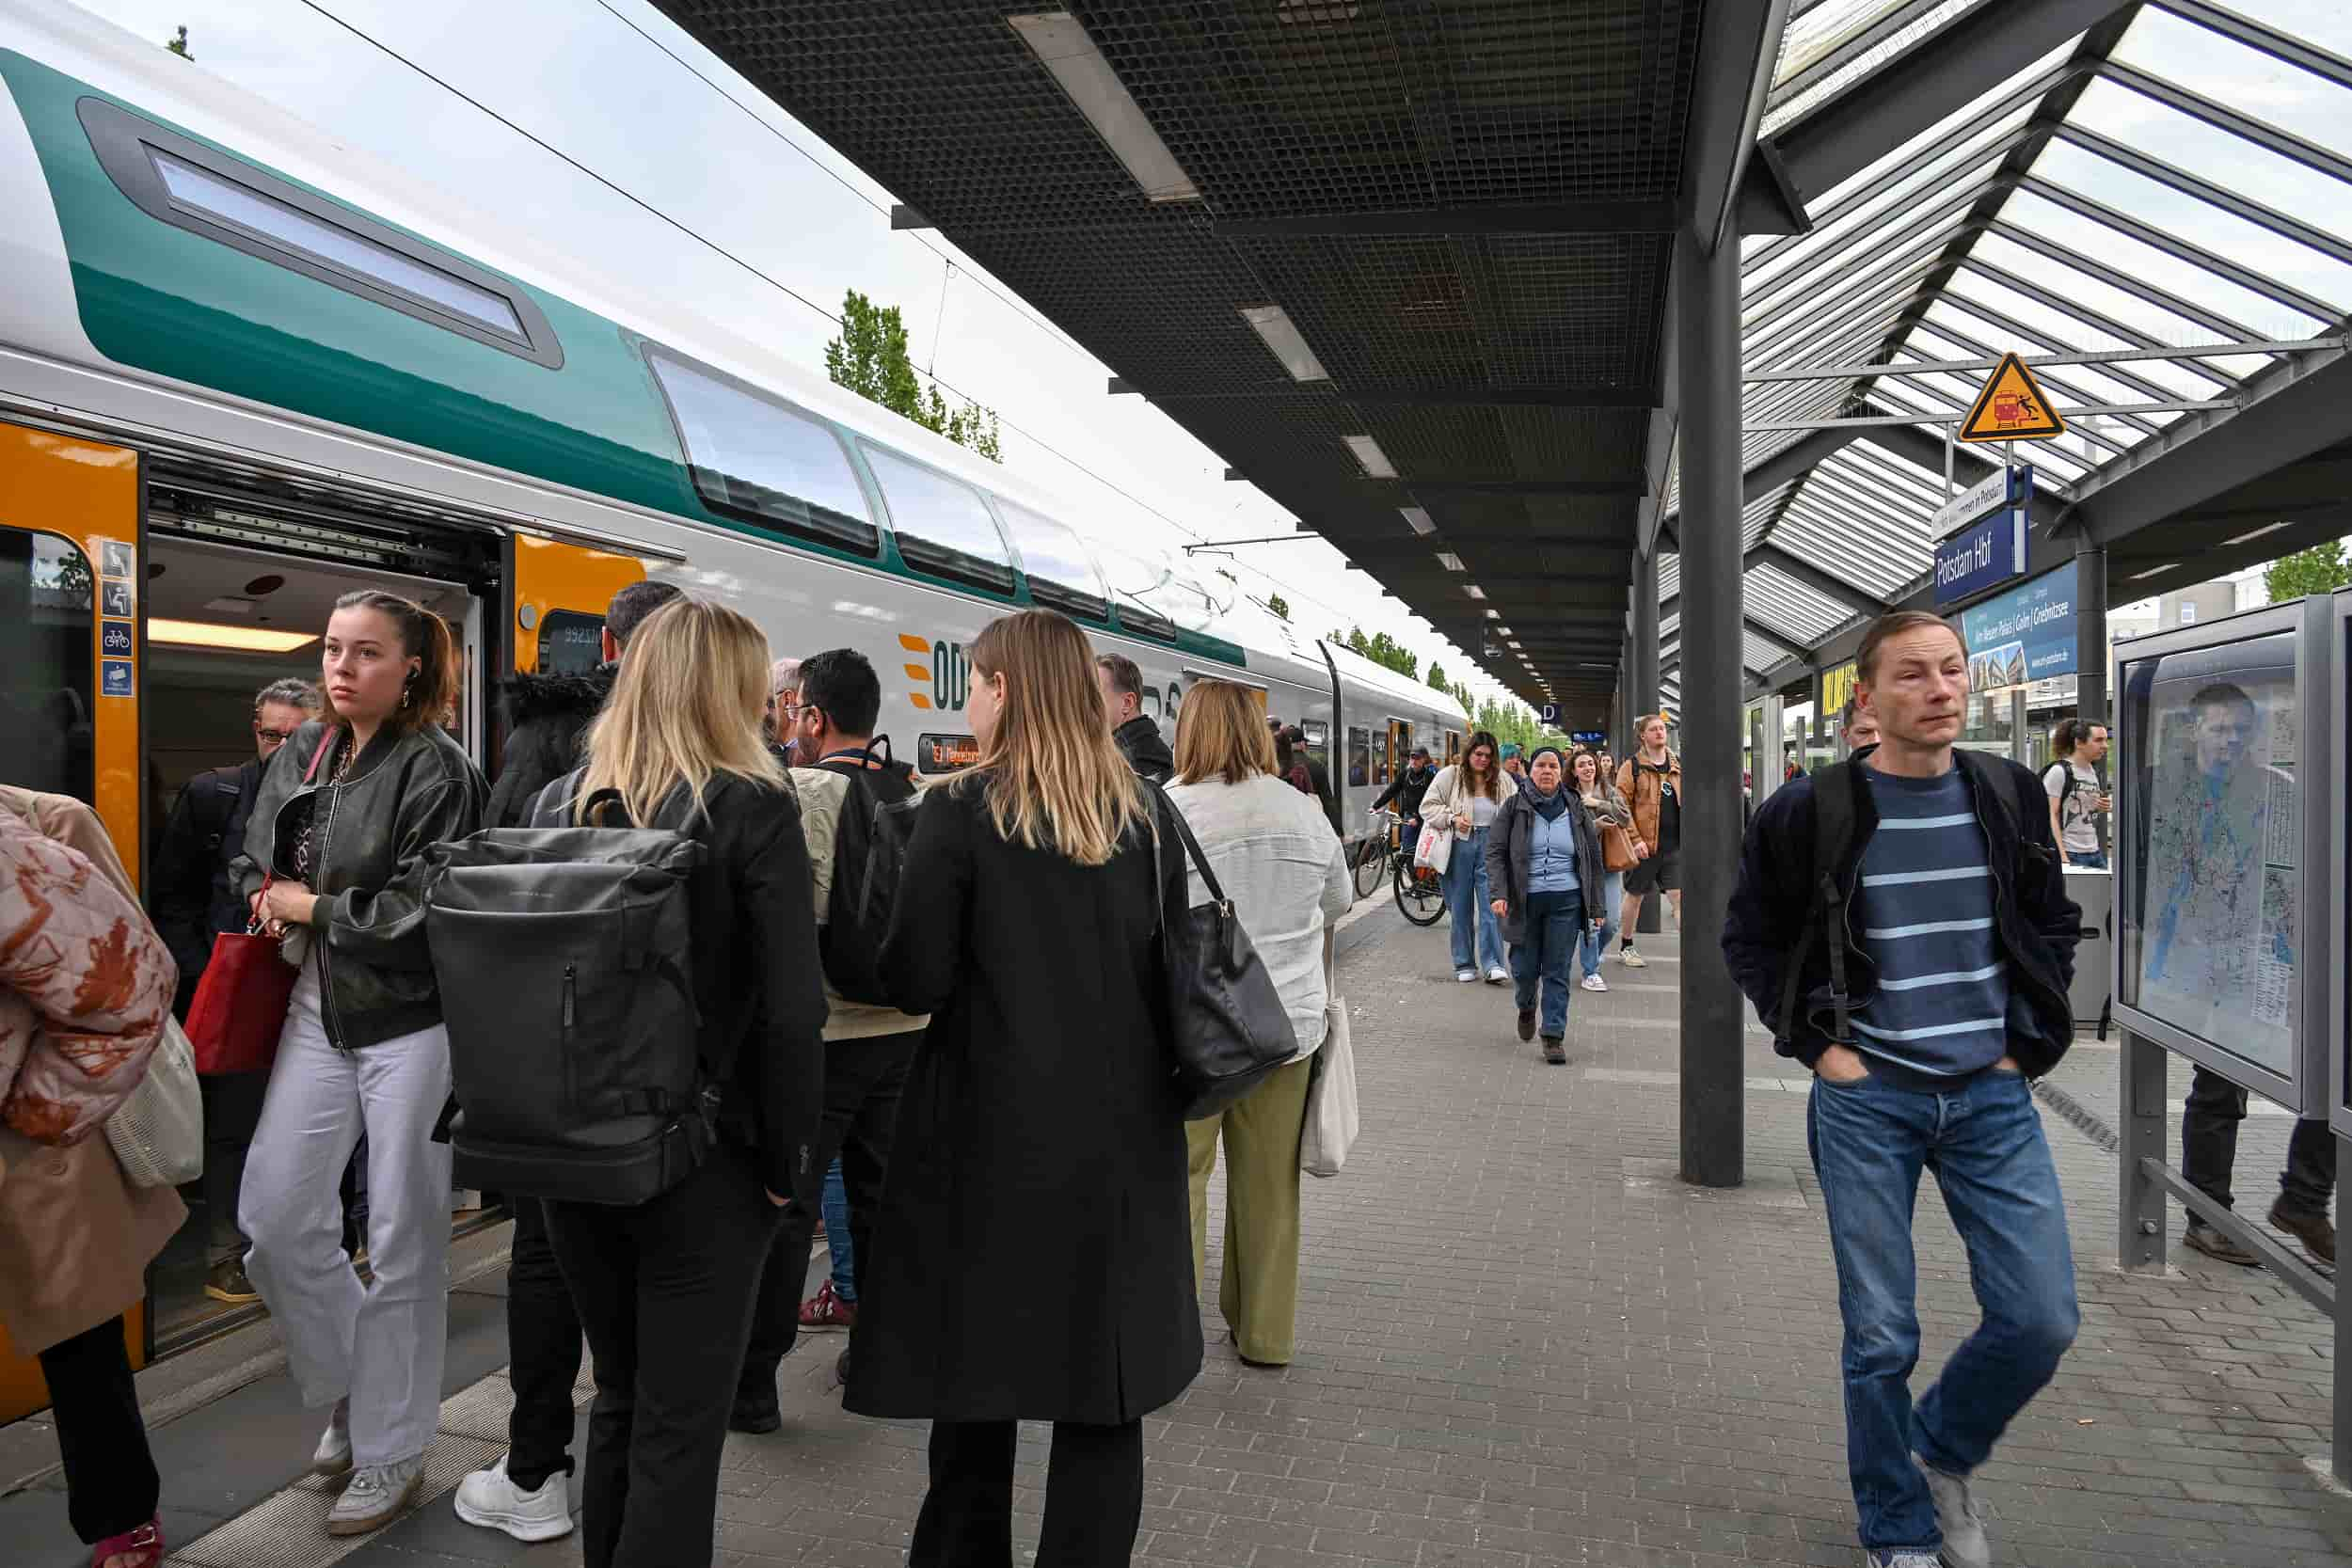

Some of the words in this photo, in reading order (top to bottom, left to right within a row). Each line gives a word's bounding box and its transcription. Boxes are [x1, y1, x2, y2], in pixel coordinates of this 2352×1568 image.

[1937, 549, 1973, 588] Potsdam
[1975, 531, 1992, 570] Hbf
[2016, 609, 2030, 631] Golm
[2034, 601, 2069, 625] Griebnitzsee
[934, 640, 965, 710] OD
[1543, 705, 1555, 721] D
